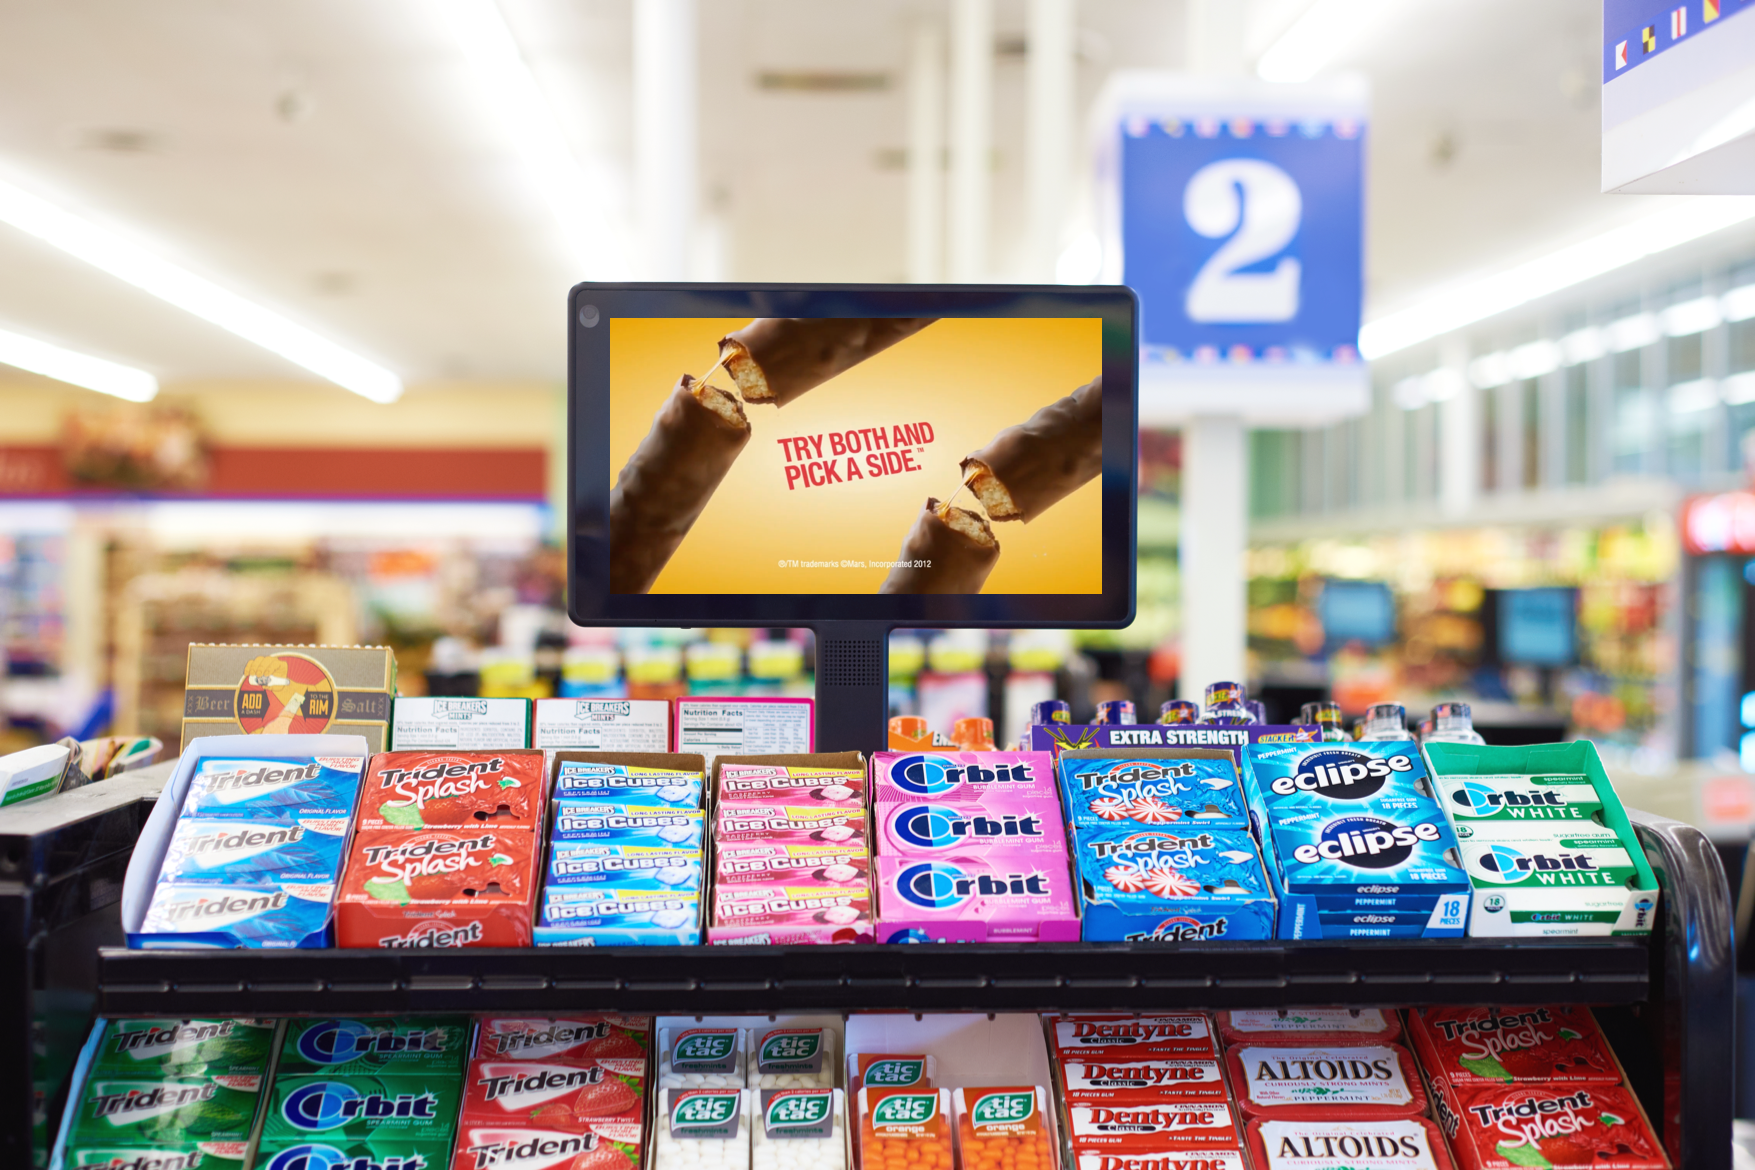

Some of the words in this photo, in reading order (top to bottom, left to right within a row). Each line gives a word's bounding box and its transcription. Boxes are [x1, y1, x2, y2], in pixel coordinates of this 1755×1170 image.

[1183, 158, 1302, 323] 2
[777, 434, 823, 462] TRY
[828, 427, 890, 456] BOTH
[893, 422, 934, 447] AND
[784, 459, 843, 490] PICK
[847, 457, 864, 481] A
[866, 449, 922, 477] SIDE.
[841, 560, 867, 568] ©Mars,
[869, 560, 912, 568] Incorporated
[914, 560, 931, 568] 2012
[194, 696, 230, 713] Beer
[242, 693, 262, 709] ADD
[309, 700, 329, 715] RIM
[341, 698, 376, 713] Salt
[434, 700, 447, 713] ICE
[448, 701, 487, 714] BREAKERS
[1110, 731, 1163, 744] EXTRA
[1167, 730, 1249, 745] STRENGTH
[1258, 734, 1295, 743] STACKER
[564, 767, 574, 775] ICE
[575, 767, 616, 775] BREAKERS
[726, 770, 739, 778] ICE
[740, 768, 777, 777] BREAKERS
[891, 755, 1035, 794] Orbit
[1270, 755, 1413, 795] eclipse
[202, 764, 321, 794] Trident
[386, 772, 492, 809] Splash
[562, 807, 573, 815] ICE
[574, 806, 615, 815] BREAKERS
[723, 809, 736, 817] ICE
[737, 808, 776, 816] BREAKERS
[1506, 808, 1582, 818] WHITE
[1294, 823, 1440, 864] eclipse
[1535, 873, 1616, 885] WHITE
[1357, 886, 1399, 894] eclipse
[1490, 898, 1500, 906] 18
[1444, 901, 1461, 917] 18
[1353, 915, 1395, 923] eclipse
[1440, 917, 1461, 925] PIECES
[1531, 913, 1561, 921] Orbit
[1072, 1022, 1192, 1040] Dentyne
[695, 1037, 726, 1048] tic
[781, 1037, 811, 1048] tic
[686, 1047, 723, 1056] tac
[771, 1047, 809, 1056] tac
[883, 1063, 913, 1074] tic
[1082, 1064, 1204, 1083] Dentyne
[1255, 1059, 1393, 1080] ALTOIDS
[874, 1072, 912, 1082] tac
[478, 1067, 605, 1101] Trident
[696, 1098, 728, 1111] tic
[789, 1098, 821, 1111] tic
[894, 1097, 926, 1110] tic
[992, 1096, 1024, 1109] tic
[685, 1109, 725, 1120] tac
[779, 1109, 818, 1120] tac
[885, 1108, 925, 1119] tac
[983, 1106, 1023, 1119] tac
[1089, 1108, 1214, 1129] Dentyne
[886, 1124, 925, 1133] orange
[1277, 1136, 1420, 1158] ALTOIDS
